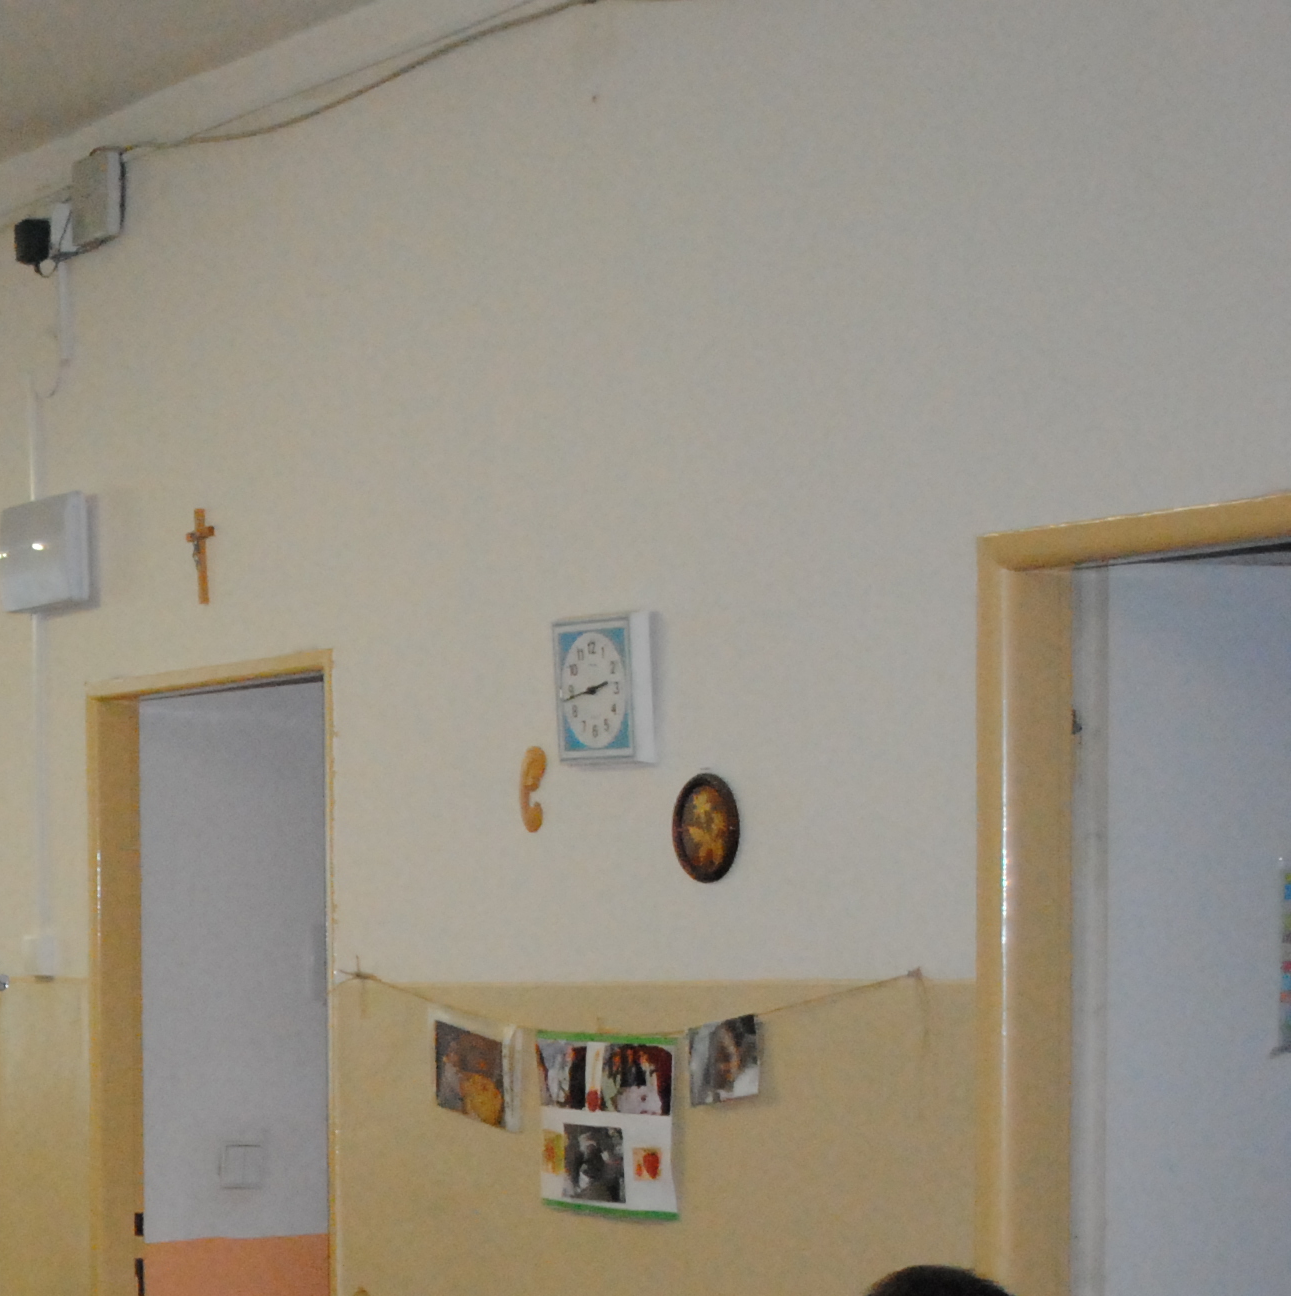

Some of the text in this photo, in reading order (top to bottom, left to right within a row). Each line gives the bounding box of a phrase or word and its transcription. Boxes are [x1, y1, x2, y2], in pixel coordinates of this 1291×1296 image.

[577, 648, 585, 661] 11
[587, 641, 597, 655] 12
[601, 646, 606, 659] 1
[569, 663, 578, 676] 10
[610, 661, 616, 674] 2
[568, 684, 575, 698] 9
[613, 681, 620, 695] 3
[572, 704, 578, 718] 8
[611, 704, 617, 715] 4
[582, 720, 587, 733] 7
[592, 724, 599, 738] 6
[604, 718, 610, 732] 5
